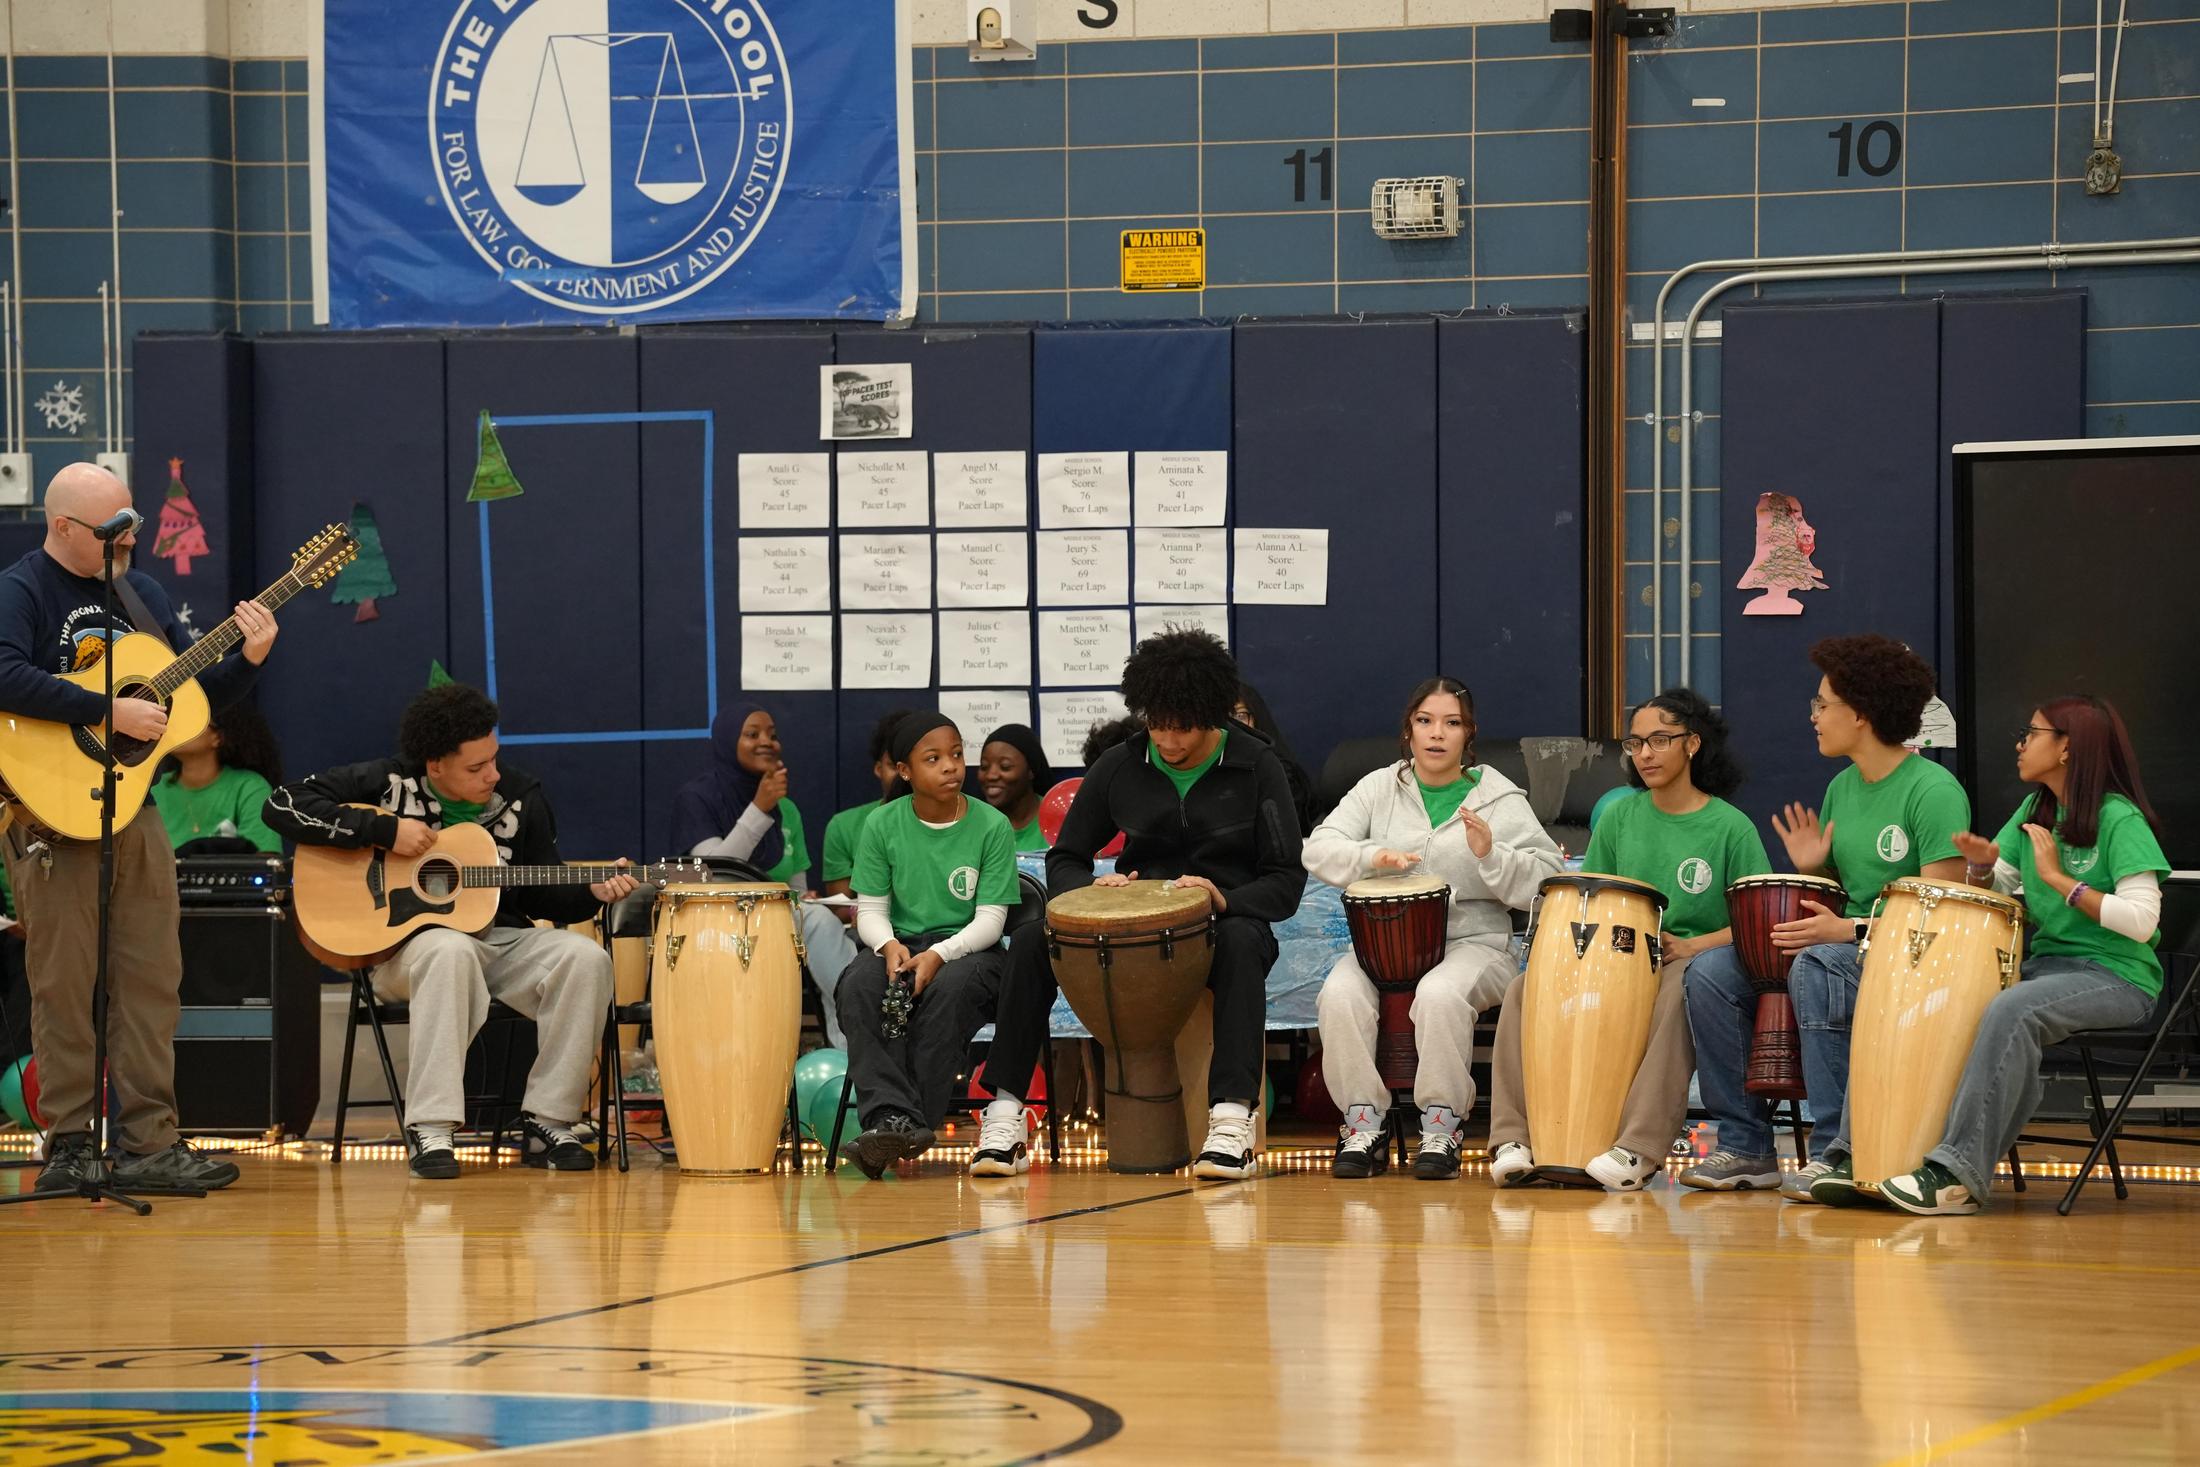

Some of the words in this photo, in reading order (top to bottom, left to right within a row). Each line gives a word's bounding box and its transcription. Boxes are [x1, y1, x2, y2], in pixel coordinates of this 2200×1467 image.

[444, 15, 495, 107] THE
[1828, 121, 1902, 178] 10
[1283, 148, 1332, 203] 11
[443, 130, 472, 189] FOR
[459, 188, 508, 254] LAW,
[688, 227, 734, 278] AND
[728, 122, 779, 231] JUSTICE
[1129, 232, 1197, 247] WARNING
[852, 384, 874, 395] PACER
[876, 380, 893, 390] TEST
[860, 390, 890, 402] SCORES
[961, 463, 986, 474] Angel
[1064, 466, 1090, 476] Sergio
[1093, 466, 1104, 475] M.
[1158, 466, 1195, 474] Aminata
[878, 488, 888, 496] 45
[1080, 492, 1090, 500] 76
[762, 502, 785, 510] Pacer
[788, 502, 807, 512] Laps
[862, 501, 883, 509] Pacer
[887, 501, 906, 511] Laps
[959, 501, 981, 510] Pacer
[984, 501, 1003, 511] Laps
[1062, 505, 1084, 513] Pacer
[1088, 504, 1108, 514] Laps
[1158, 504, 1180, 512] Pacer
[1183, 504, 1203, 514] Laps
[961, 544, 993, 552] Manuel
[1159, 543, 1193, 552] Arianna
[1256, 543, 1286, 551] Alanna
[780, 573, 790, 581] 44
[1078, 570, 1088, 578] 69
[1276, 568, 1286, 576] 40
[763, 586, 786, 594] Pacer
[788, 586, 808, 596] Laps
[864, 583, 886, 592] Pacer
[889, 583, 908, 594] Laps
[960, 582, 982, 590] Pacer
[986, 582, 1006, 592] Laps
[1061, 582, 1083, 591] Pacer
[1086, 582, 1106, 593] Laps
[1158, 581, 1181, 590] Pacer
[1184, 581, 1204, 592] Laps
[1258, 581, 1280, 590] Pacer
[1284, 581, 1304, 591] Laps
[60, 622, 72, 647] THE
[67, 604, 105, 624] BRONX
[968, 622, 992, 630] Julius
[1060, 624, 1097, 633] Matthew
[1099, 624, 1110, 633] M.
[782, 652, 793, 660] 40
[882, 650, 893, 658] 40
[1081, 650, 1091, 658] 68
[765, 664, 788, 673] Pacer
[791, 664, 810, 675] Laps
[865, 663, 887, 671] Pacer
[891, 662, 910, 673] Laps
[963, 660, 985, 668] Pacer
[988, 660, 1008, 670] Laps
[1063, 662, 1086, 671] Pacer
[1089, 662, 1109, 672] Laps
[968, 702, 992, 711] Justin
[1066, 705, 1076, 715] 50
[1087, 705, 1107, 714] Club
